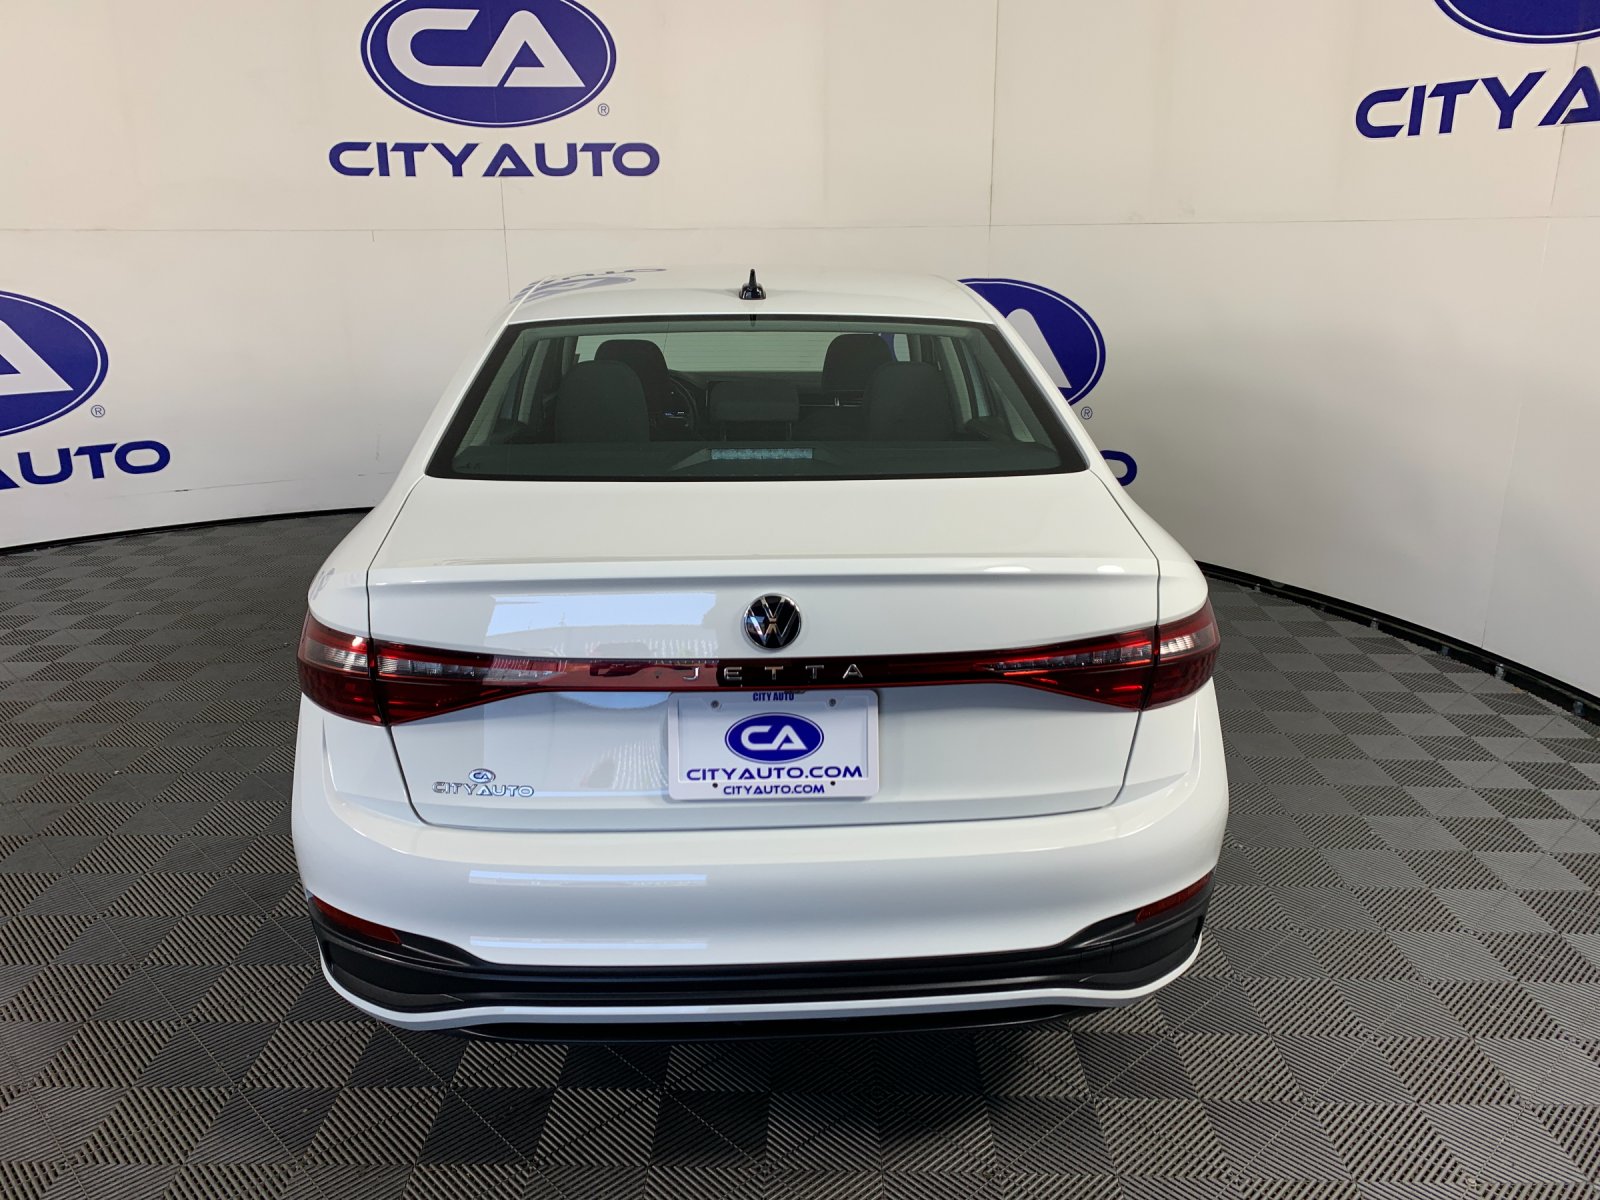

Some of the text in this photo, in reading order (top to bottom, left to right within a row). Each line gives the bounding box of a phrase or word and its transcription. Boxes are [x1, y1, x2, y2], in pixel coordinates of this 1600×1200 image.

[387, 8, 586, 88] CA
[682, 663, 863, 681] JETTA
[752, 690, 795, 702] CITY AUTO
[741, 725, 808, 751] CA
[686, 766, 863, 781] CITYAUTO.COM
[723, 784, 825, 796] CITYAUTO.COM
